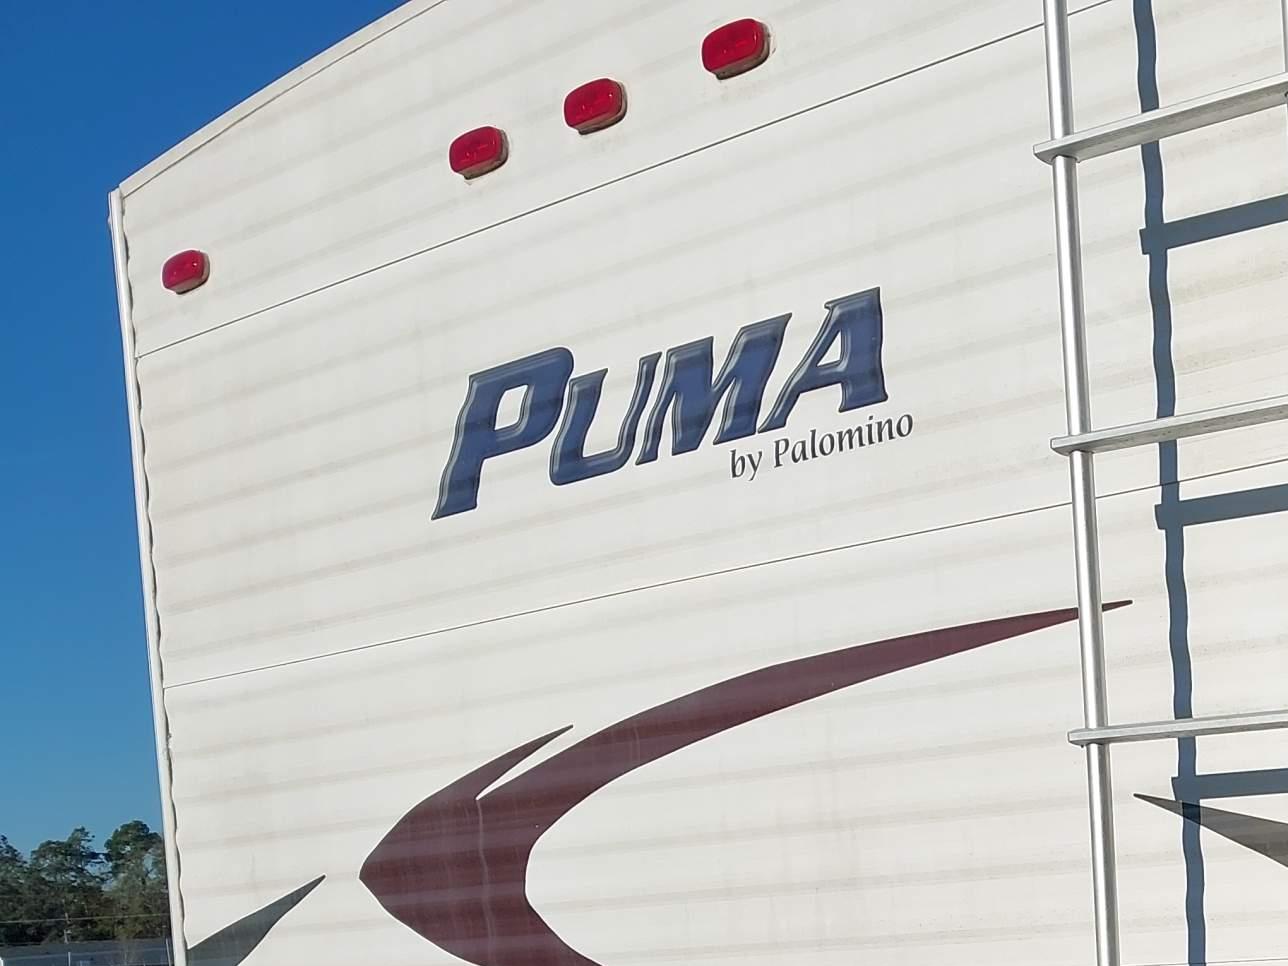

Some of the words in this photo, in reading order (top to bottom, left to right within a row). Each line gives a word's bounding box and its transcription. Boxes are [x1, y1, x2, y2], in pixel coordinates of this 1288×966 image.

[431, 287, 889, 520] PUMA
[730, 448, 763, 482] by
[774, 414, 913, 468] Palomino
